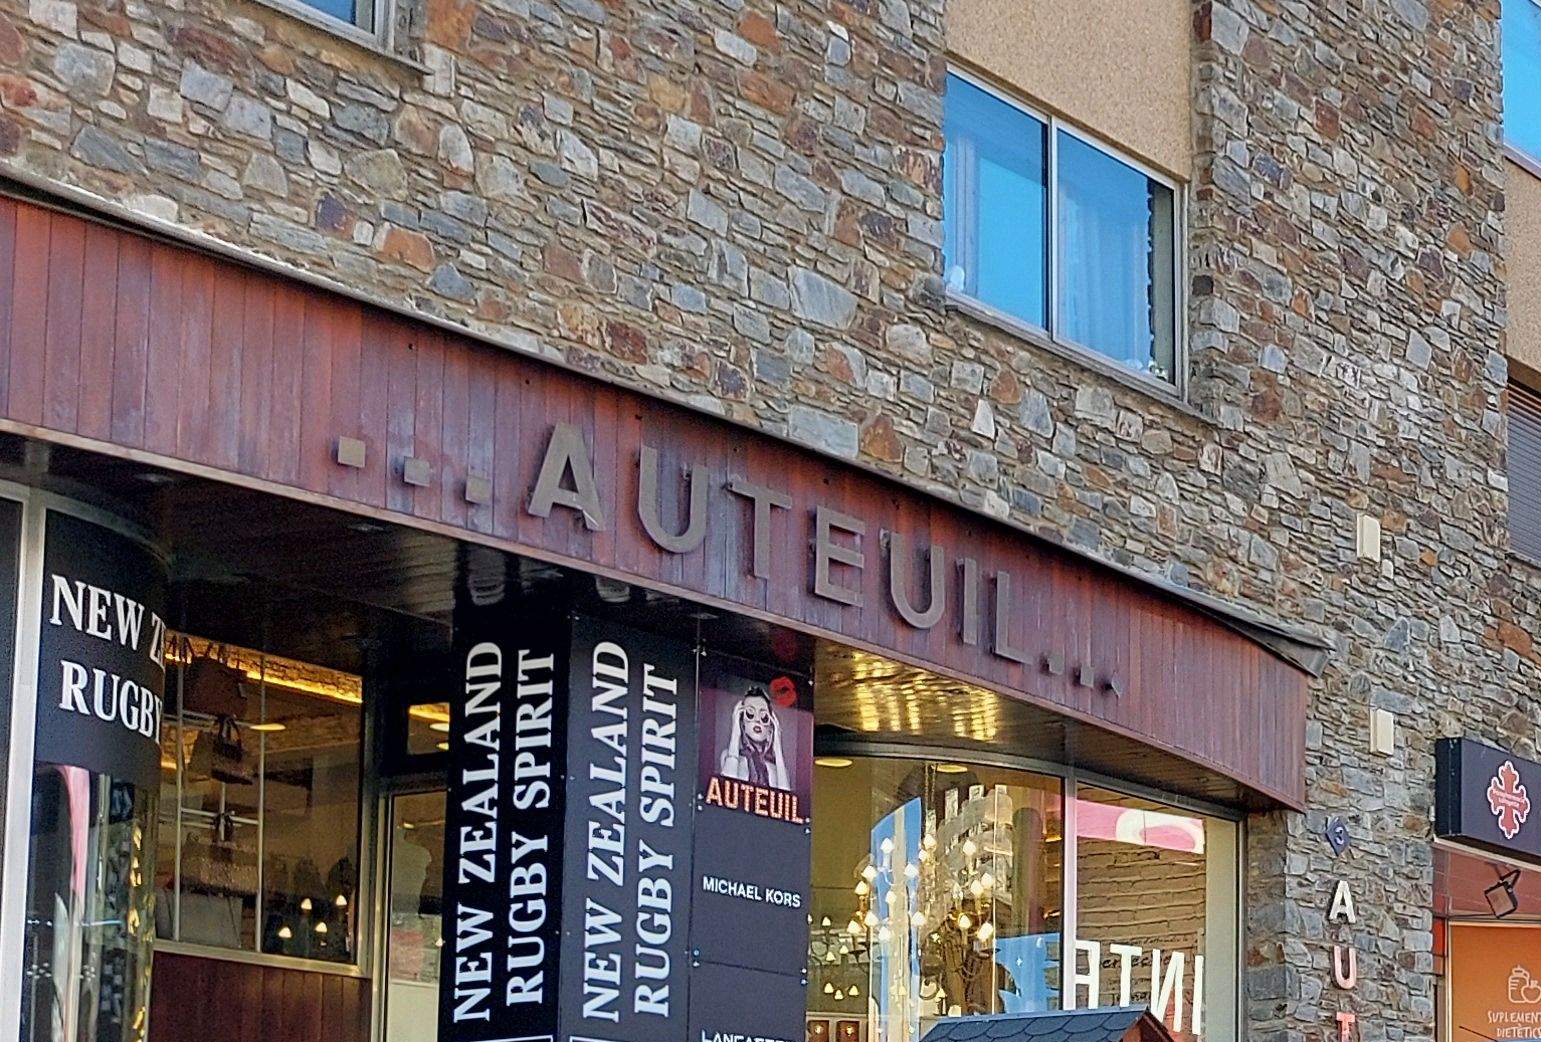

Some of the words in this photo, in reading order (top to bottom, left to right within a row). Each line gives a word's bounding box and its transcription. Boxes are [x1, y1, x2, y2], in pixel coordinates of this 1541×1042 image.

[50, 573, 145, 651] NEW
[58, 659, 163, 745] RUGBY
[458, 641, 502, 884] ZEALAND
[513, 649, 554, 810] SPIRIT
[587, 641, 629, 888] ZEALAND
[639, 663, 678, 828] SPIRIT
[706, 776, 804, 825] AUTEUIL
[453, 903, 497, 1024] NEW
[505, 832, 548, 1007] RUGBY
[583, 897, 625, 1024] NEW
[634, 839, 674, 1018] RUGBY
[703, 875, 763, 902] MICHAEL
[766, 889, 802, 909] KORS
